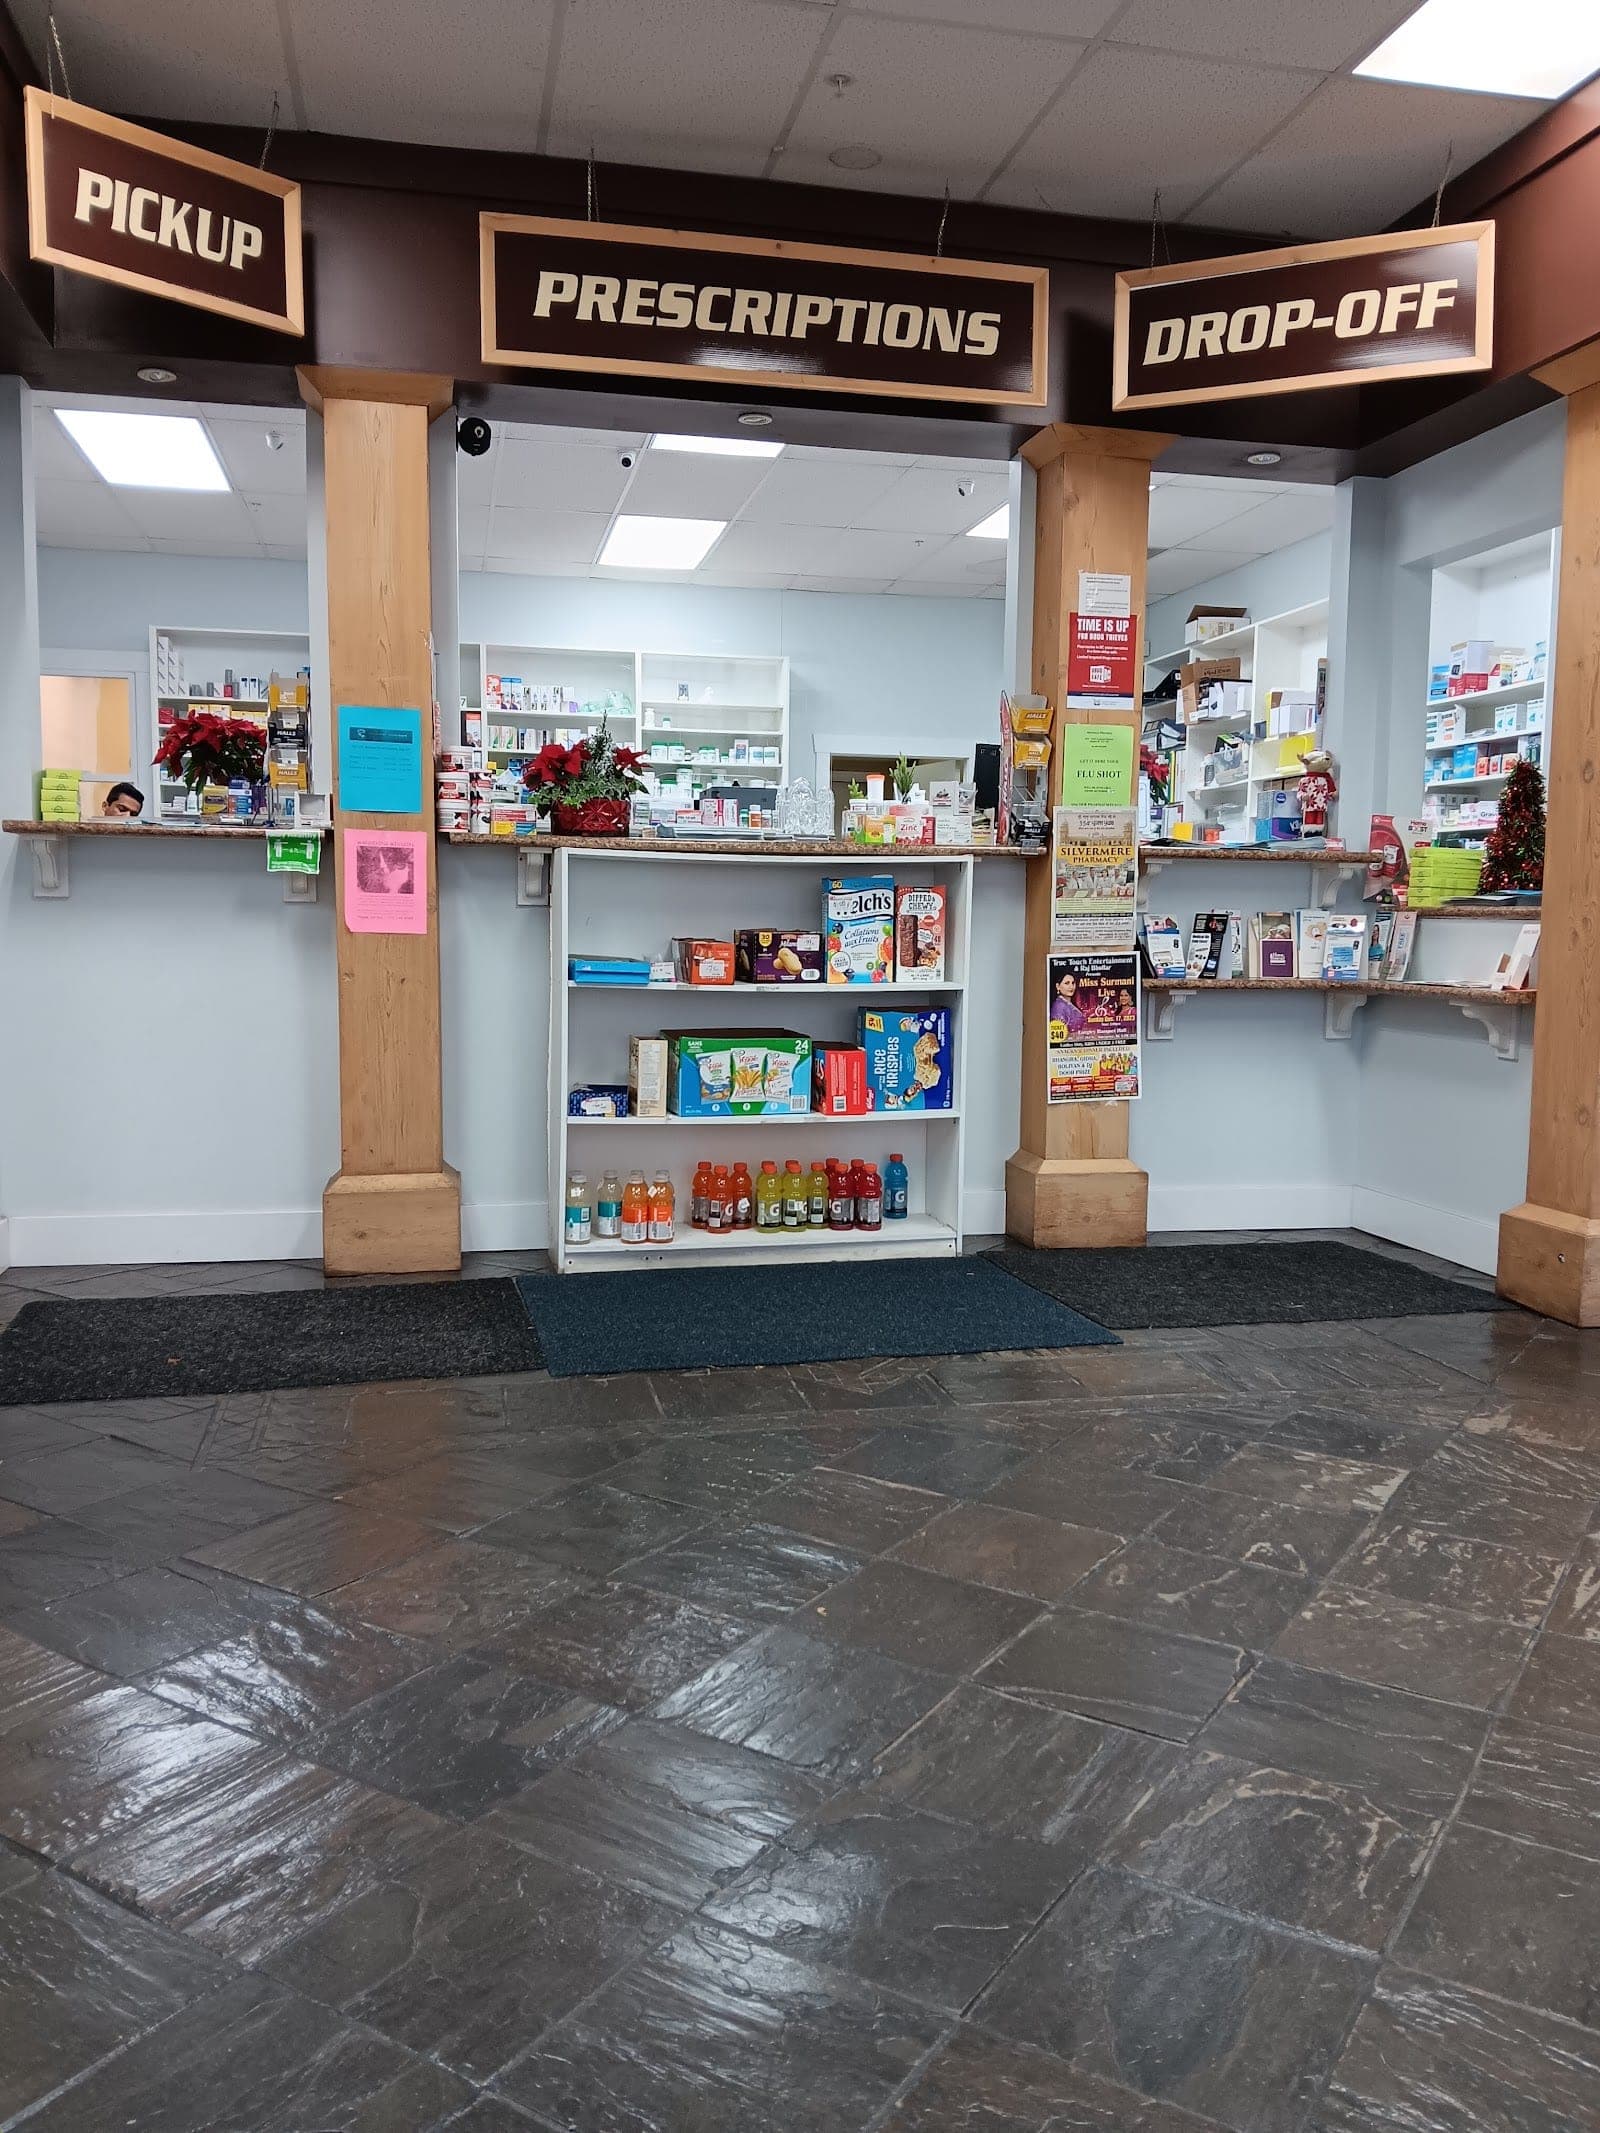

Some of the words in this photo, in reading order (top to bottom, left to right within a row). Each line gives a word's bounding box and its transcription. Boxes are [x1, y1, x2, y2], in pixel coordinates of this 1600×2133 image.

[74, 166, 264, 270] PICKUP
[532, 270, 1002, 356] PRESCRIPTIONS
[1142, 278, 1459, 366] DROP-OFF
[1077, 618, 1101, 632] TIME
[1104, 619, 1113, 633] IS
[1116, 620, 1130, 633] UP
[276, 730, 297, 738] HALLS
[1077, 770, 1095, 779] FLU
[1096, 770, 1122, 779] SHOT
[900, 823, 918, 831] Zinc
[1060, 847, 1131, 856] SILVERMERE
[1073, 856, 1120, 864] PHARMACY
[836, 893, 892, 915] elch's
[844, 927, 880, 940] Collations
[1052, 959, 1067, 967] True
[1068, 958, 1087, 966] Touch
[1088, 956, 1133, 965] Entertainment
[1079, 978, 1098, 988] Miss
[1098, 988, 1116, 998] Live
[1051, 1031, 1064, 1040] $40
[795, 1040, 809, 1049] 24
